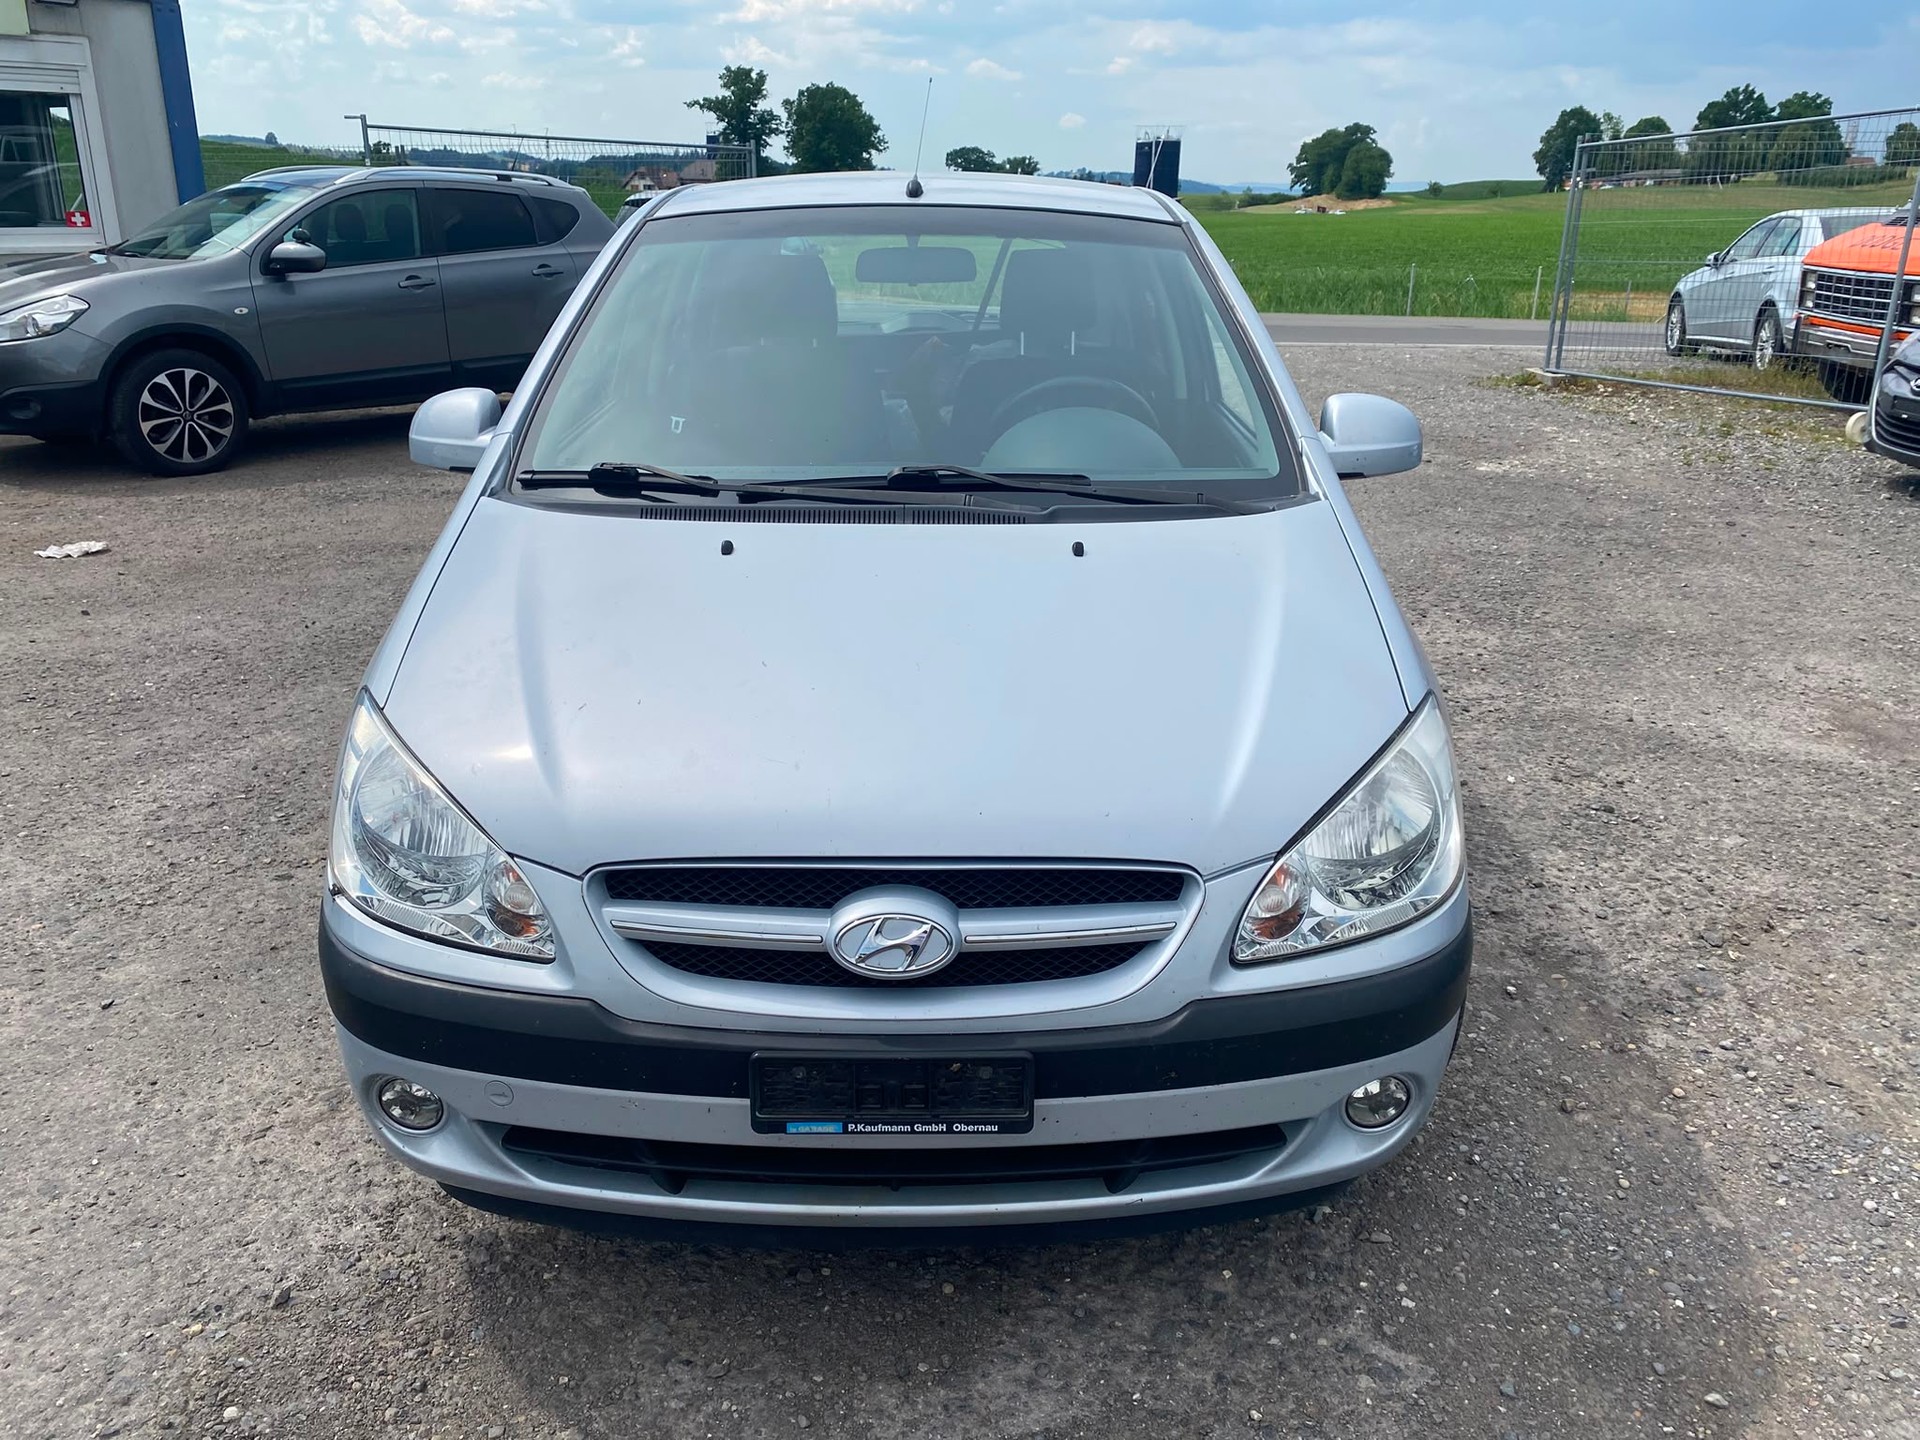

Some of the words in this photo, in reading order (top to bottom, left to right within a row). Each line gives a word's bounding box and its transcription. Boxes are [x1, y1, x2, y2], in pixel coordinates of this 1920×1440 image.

[847, 1123, 911, 1132] P.Kaufmann
[914, 1123, 947, 1132] GmbH
[952, 1123, 999, 1132] Obernau
